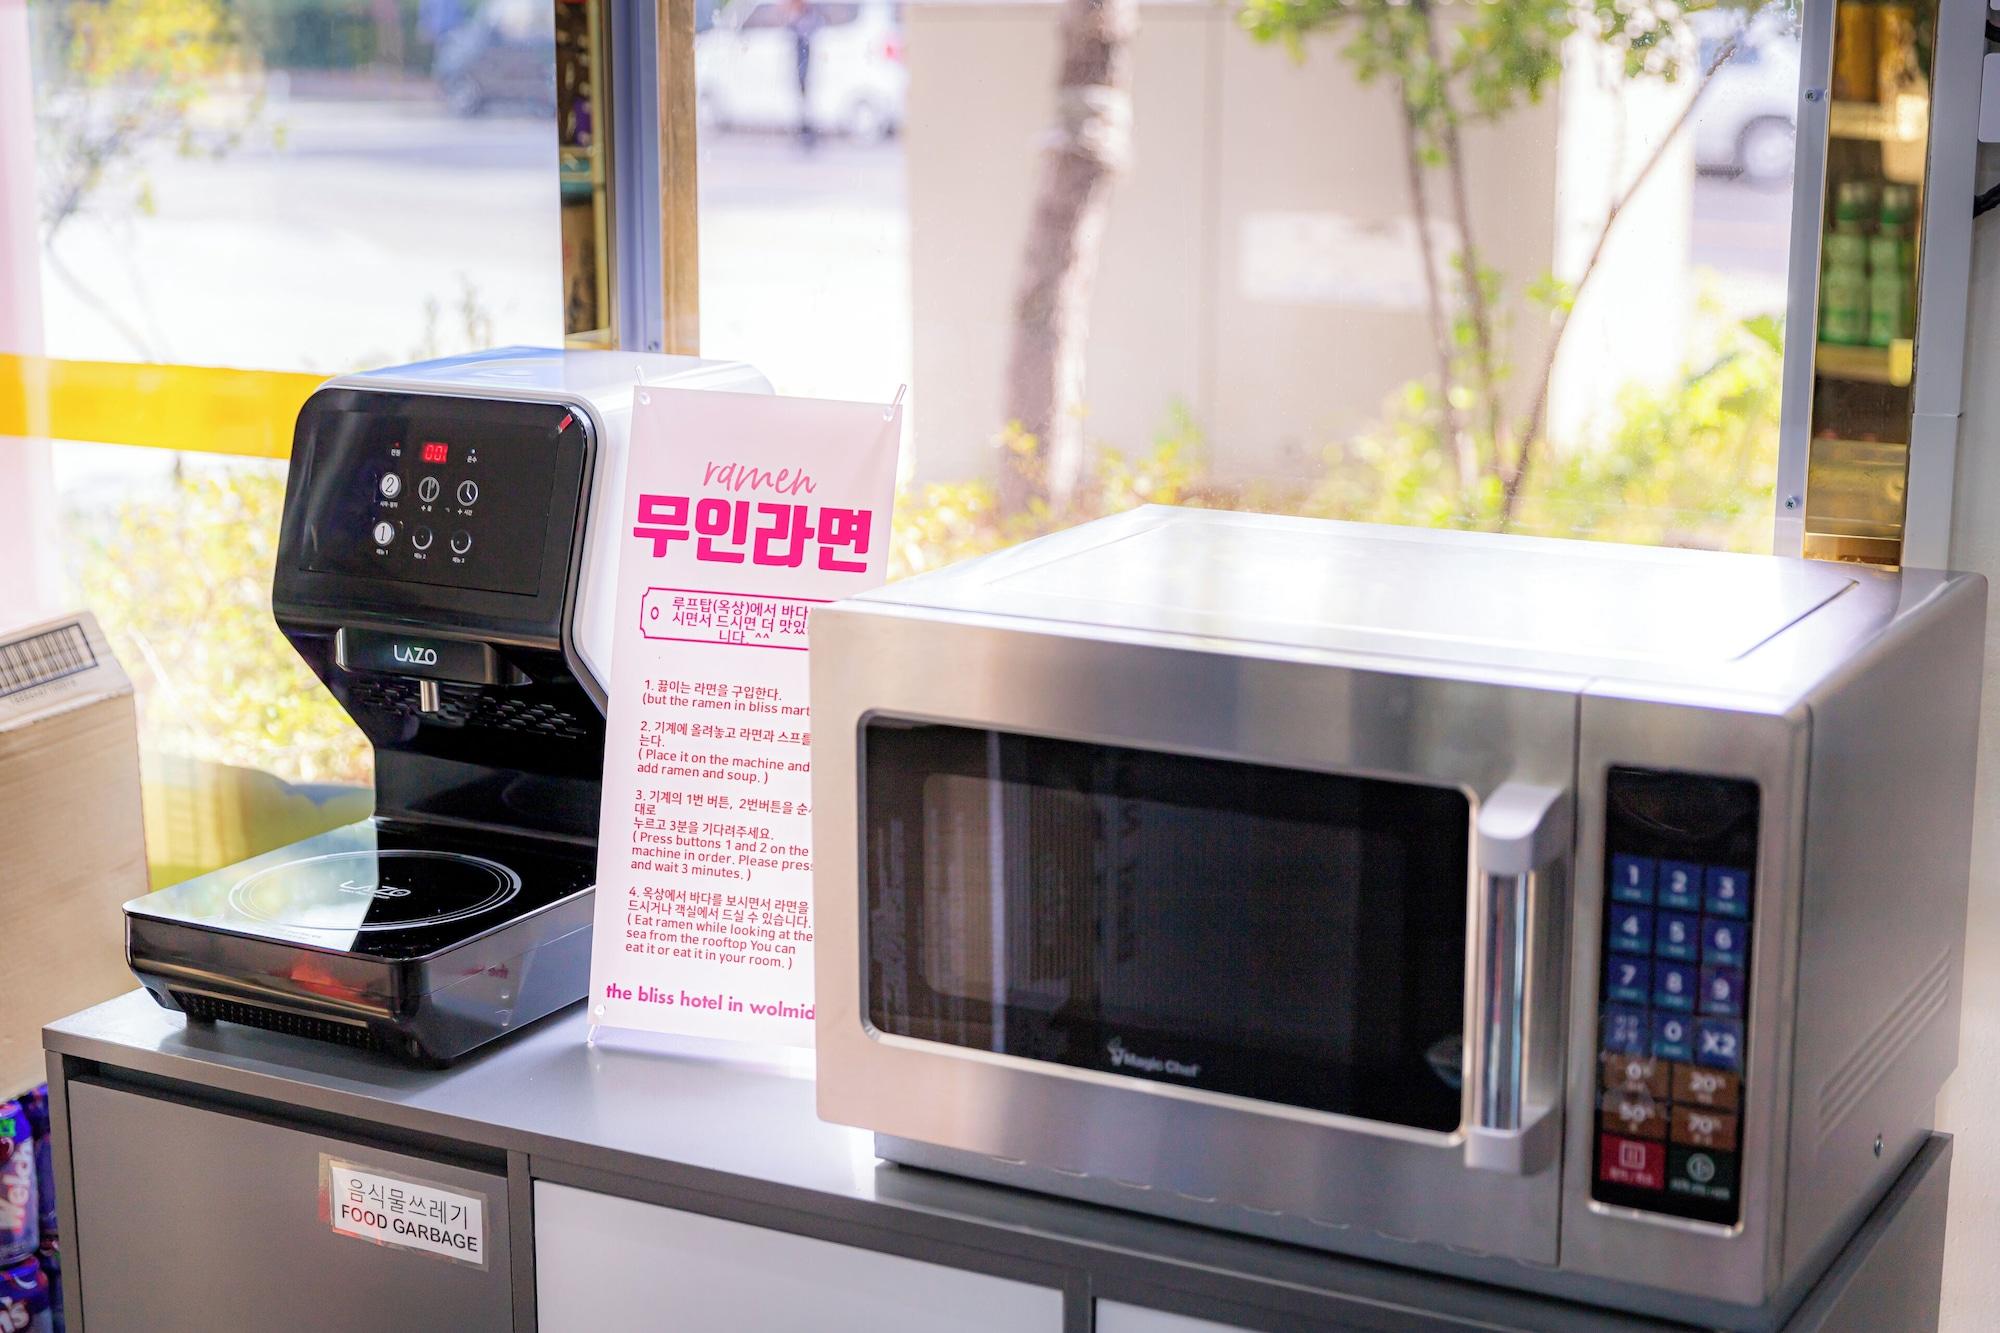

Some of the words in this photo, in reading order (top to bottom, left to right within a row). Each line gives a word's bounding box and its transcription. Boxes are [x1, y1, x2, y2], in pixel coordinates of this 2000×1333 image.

[703, 461, 817, 495] ramen
[633, 494, 872, 573] 무인라면
[672, 596, 777, 618] 루프탑(옥상)에서
[672, 611, 712, 628] 시면서
[716, 615, 757, 631] 드시면
[761, 618, 774, 632] 더
[779, 619, 809, 635] 맛있
[393, 644, 437, 665] LAZO
[644, 679, 654, 691] 1.
[694, 682, 729, 698] 라면을
[731, 685, 782, 701] 구입한다.
[642, 692, 667, 705] (but
[669, 695, 689, 707] the
[692, 699, 731, 710] ramen
[734, 699, 746, 711] in
[748, 700, 778, 714] bliss
[781, 705, 810, 716] mart
[639, 733, 665, 748] 는다.
[640, 720, 651, 732] 2.
[654, 721, 688, 736] 기계에
[690, 723, 736, 739] 올려놓고
[739, 727, 775, 743] 라면과
[645, 748, 677, 762] Place
[680, 751, 689, 763] it
[691, 754, 707, 764] on
[709, 753, 729, 766] the
[732, 757, 784, 772] machine
[787, 761, 810, 773] and
[637, 762, 659, 774] add
[661, 766, 700, 777] ramen
[702, 768, 724, 779] and
[726, 771, 760, 785] soup.
[634, 802, 656, 816] 대로
[635, 789, 646, 801] 3.
[649, 790, 682, 805] 기계의
[686, 793, 704, 807] 1번
[706, 794, 733, 810] 버튼,
[738, 798, 794, 815] 2번버튼을
[796, 802, 811, 816] 순
[633, 816, 666, 830] 누르고
[669, 819, 699, 835] 3분을
[702, 822, 774, 840] 기다려주세요.
[640, 831, 673, 845] Press
[675, 834, 721, 849] buttons
[725, 839, 731, 850] 1
[734, 841, 757, 853] and
[759, 842, 767, 853] 2
[769, 845, 786, 855] on
[788, 844, 809, 857] the
[631, 846, 681, 859] machine
[684, 848, 695, 861] in
[697, 851, 735, 865] order.
[738, 854, 778, 868] Please
[630, 859, 652, 870] and
[654, 861, 679, 873] wait
[681, 863, 688, 874] 3
[691, 864, 743, 880] minutes.
[1628, 863, 1639, 886] 1
[1671, 869, 1688, 893] 2
[1719, 875, 1735, 899] 3
[628, 886, 639, 898] 4.
[642, 886, 687, 903] 옥상에서
[689, 891, 723, 907] 바다를
[725, 895, 771, 912] 보시면서
[774, 899, 809, 915] 라면을
[627, 899, 672, 916] 드시거나
[674, 903, 719, 921] 객실에서
[721, 908, 744, 923] 드실
[747, 911, 759, 924] 수
[762, 912, 811, 929] 있습니다.
[1622, 914, 1639, 936] 4
[634, 914, 653, 927] Eat
[655, 918, 693, 930] ramen
[695, 921, 727, 934] while
[730, 923, 776, 941] looking
[778, 929, 791, 940] at
[793, 930, 813, 942] the
[1714, 927, 1732, 950] 6
[626, 929, 647, 940] sea
[649, 929, 677, 943] from
[680, 932, 699, 945] the
[702, 936, 747, 952] rooftop
[750, 940, 772, 952] You
[774, 944, 796, 955] can
[625, 943, 644, 953] eat
[646, 942, 656, 955] it
[657, 946, 670, 956] or
[672, 947, 692, 958] eat
[694, 947, 703, 959] it
[705, 948, 716, 960] in
[719, 953, 746, 964] your
[749, 956, 784, 968] room.
[1620, 963, 1636, 986] 7
[605, 982, 633, 1000] the
[637, 985, 674, 1005] bliss
[680, 990, 723, 1010] hotel
[728, 995, 743, 1013] in
[749, 1000, 815, 1020] wolmid
[1664, 1019, 1683, 1042] 0
[347, 1178, 468, 1230] 음식물쓰레기
[341, 1204, 388, 1229] FOOD
[393, 1218, 478, 1252] GARBAGE
